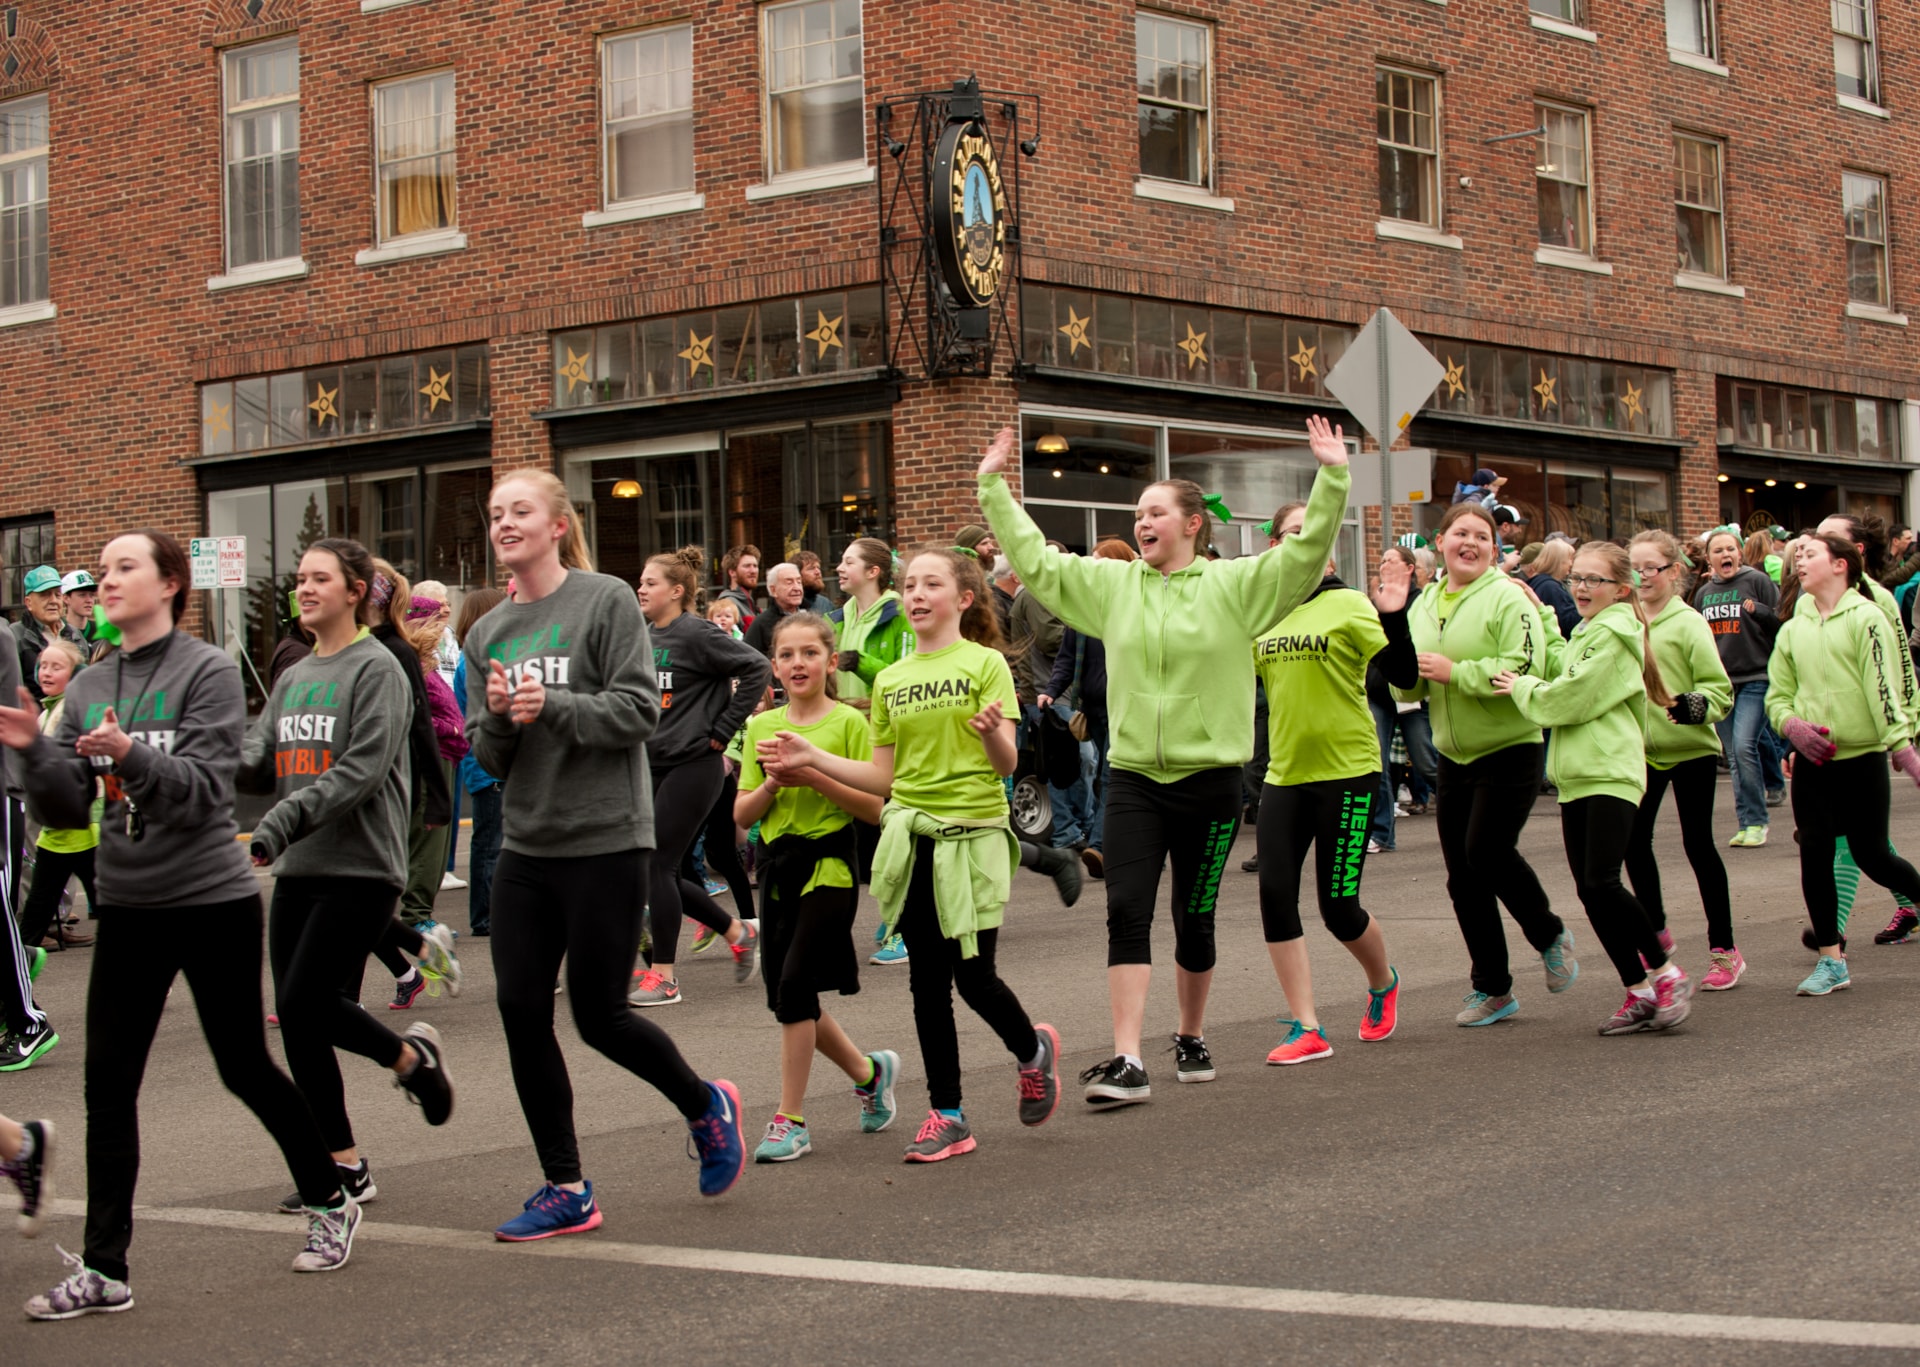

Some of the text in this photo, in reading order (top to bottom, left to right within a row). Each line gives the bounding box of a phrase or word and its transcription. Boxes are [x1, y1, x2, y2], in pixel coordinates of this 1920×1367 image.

[192, 541, 200, 556] 2
[220, 551, 245, 560] PARKING
[227, 541, 238, 550] NO
[1702, 589, 1742, 609] REEL
[1702, 604, 1742, 620] IRISH
[1709, 620, 1741, 635] REBLE
[486, 623, 571, 667] REEL
[1258, 635, 1329, 658] TIERNAN
[1283, 654, 1328, 663] DANCERS
[504, 657, 571, 695] RISH
[283, 681, 341, 710] REEL
[884, 678, 971, 710] TIERNAN
[915, 699, 969, 713] DANCERS
[83, 690, 176, 729] REEL
[1331, 791, 1352, 898] IRISH DANCERS
[1342, 791, 1372, 897] TIERNAN
[1188, 821, 1218, 914] IRISH DANCERS
[1198, 818, 1236, 913] TIERNAN
